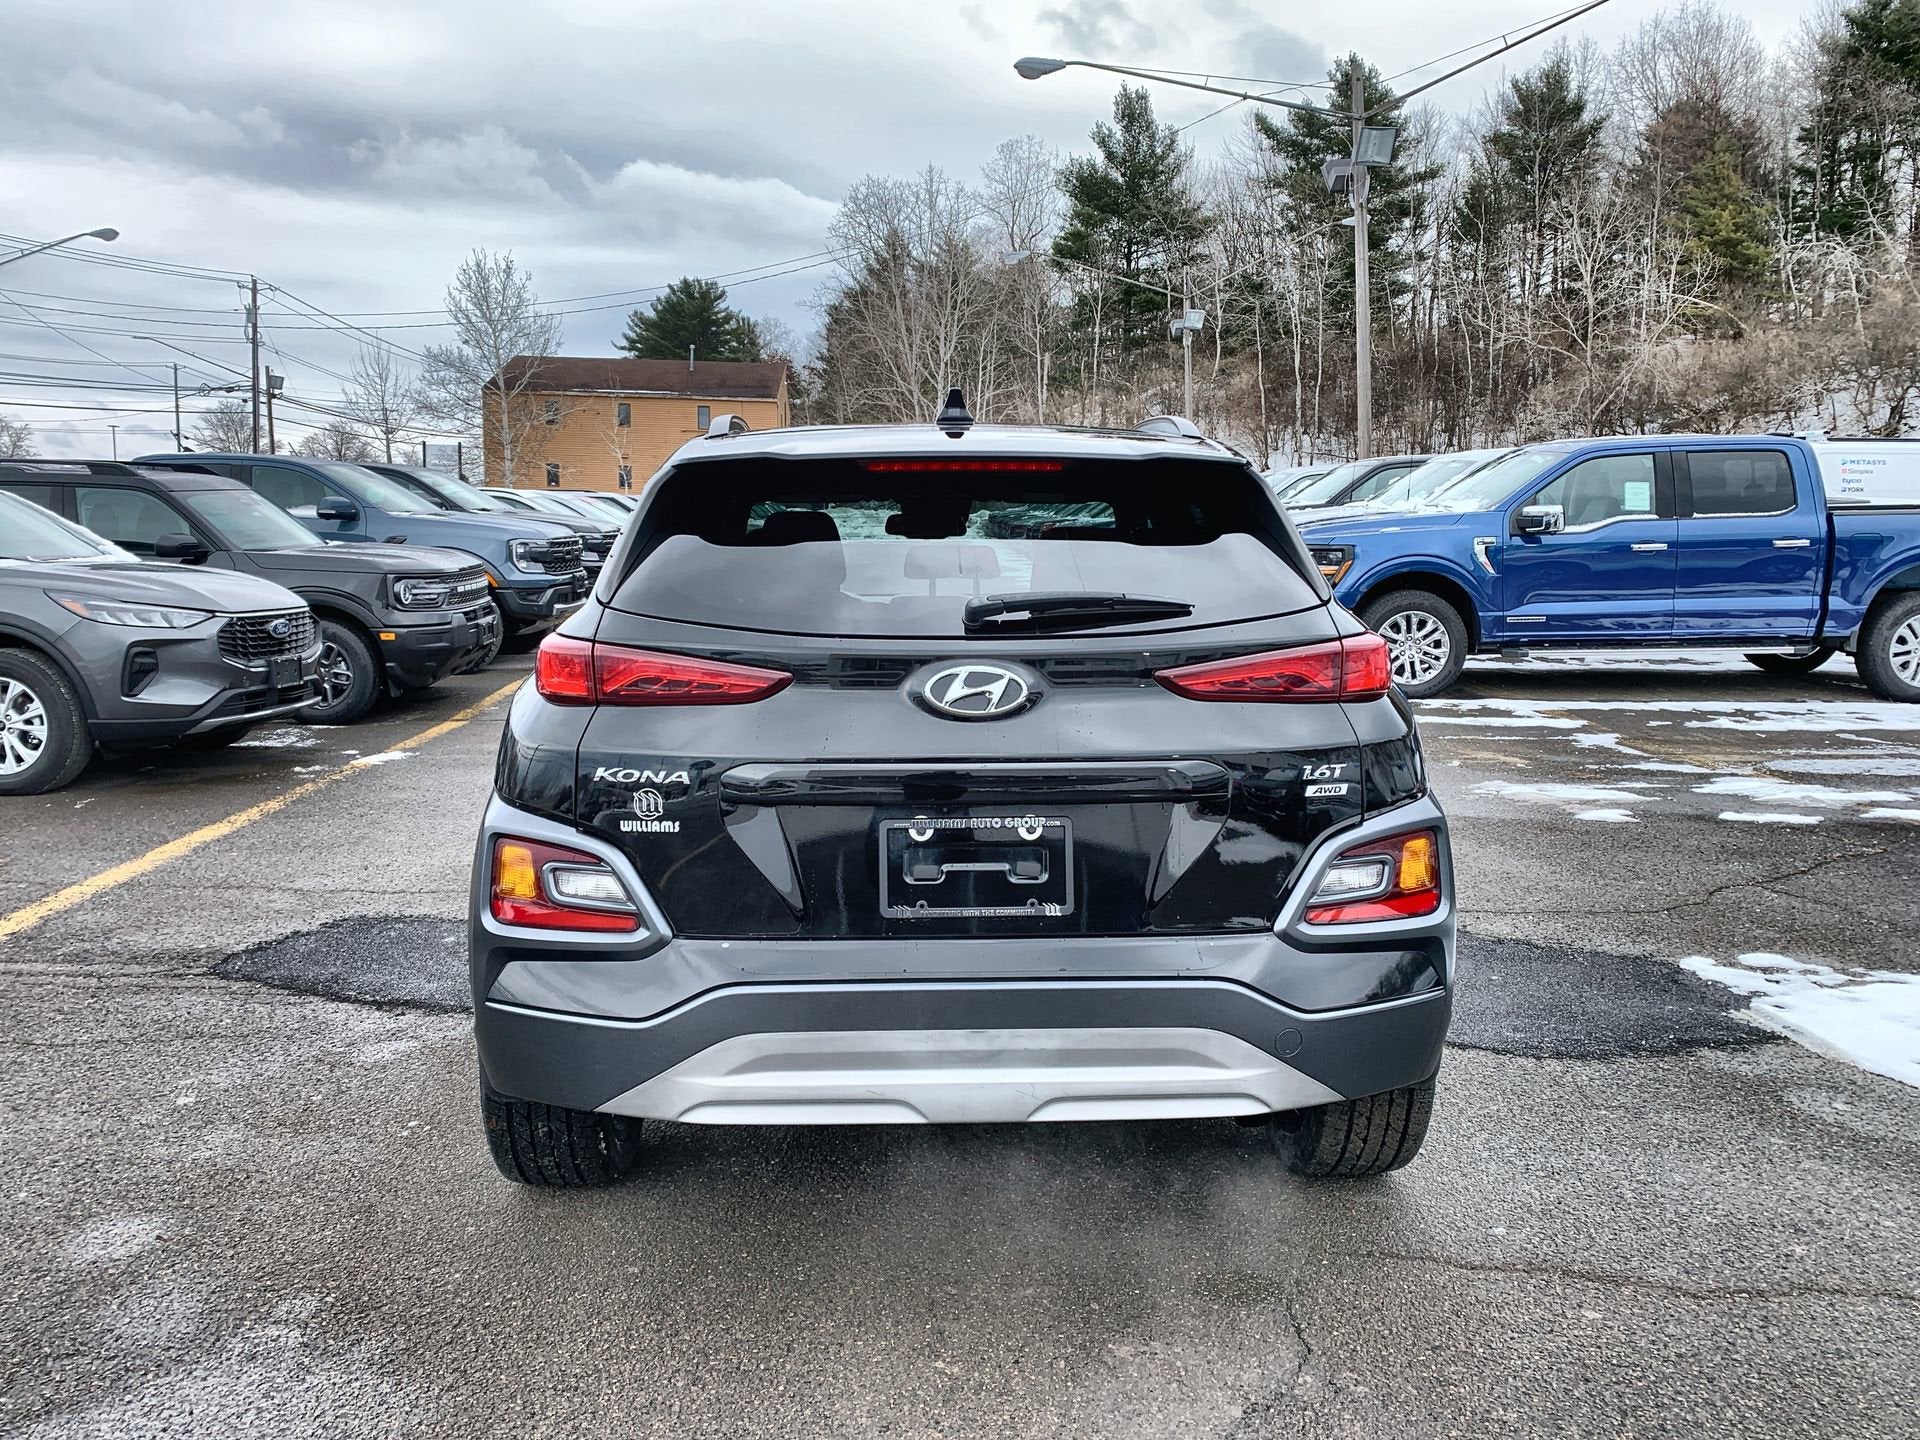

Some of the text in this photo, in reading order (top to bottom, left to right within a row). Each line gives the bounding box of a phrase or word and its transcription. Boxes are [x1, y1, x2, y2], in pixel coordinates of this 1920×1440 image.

[593, 767, 691, 785] KONA
[1312, 786, 1342, 795] AWD
[620, 820, 680, 833] WILLIAMS
[970, 817, 1001, 828] AUTO
